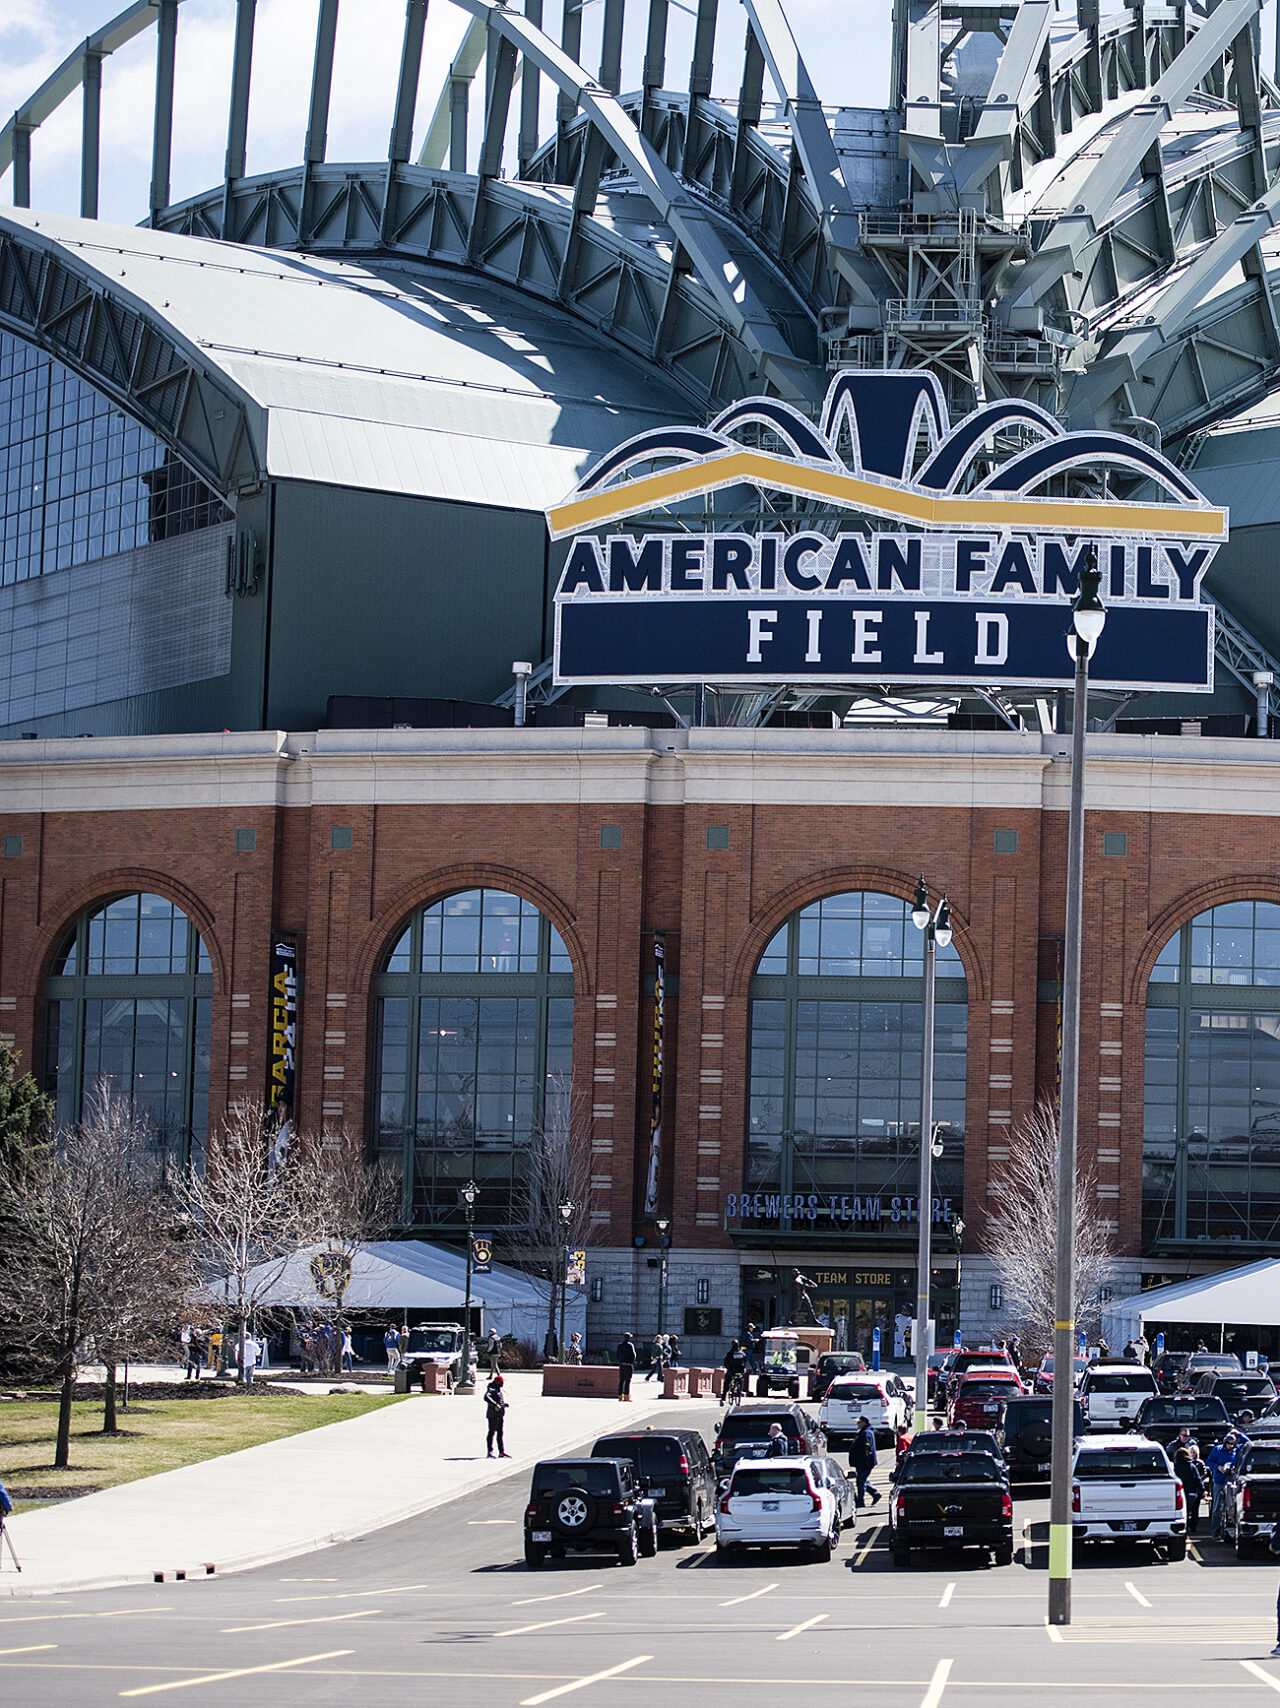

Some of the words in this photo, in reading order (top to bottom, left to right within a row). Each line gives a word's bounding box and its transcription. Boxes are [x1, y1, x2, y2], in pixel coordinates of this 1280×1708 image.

[561, 535, 922, 594] AMERICAN
[954, 541, 1211, 599] FAMILY
[746, 609, 1010, 666] FIELD
[271, 970, 288, 1107] GARCIA
[726, 1192, 819, 1221] BREWERS
[828, 1195, 882, 1223] TEAM
[889, 1196, 954, 1223] STRE
[815, 1272, 848, 1284] TEAM
[855, 1272, 892, 1285] STORE
